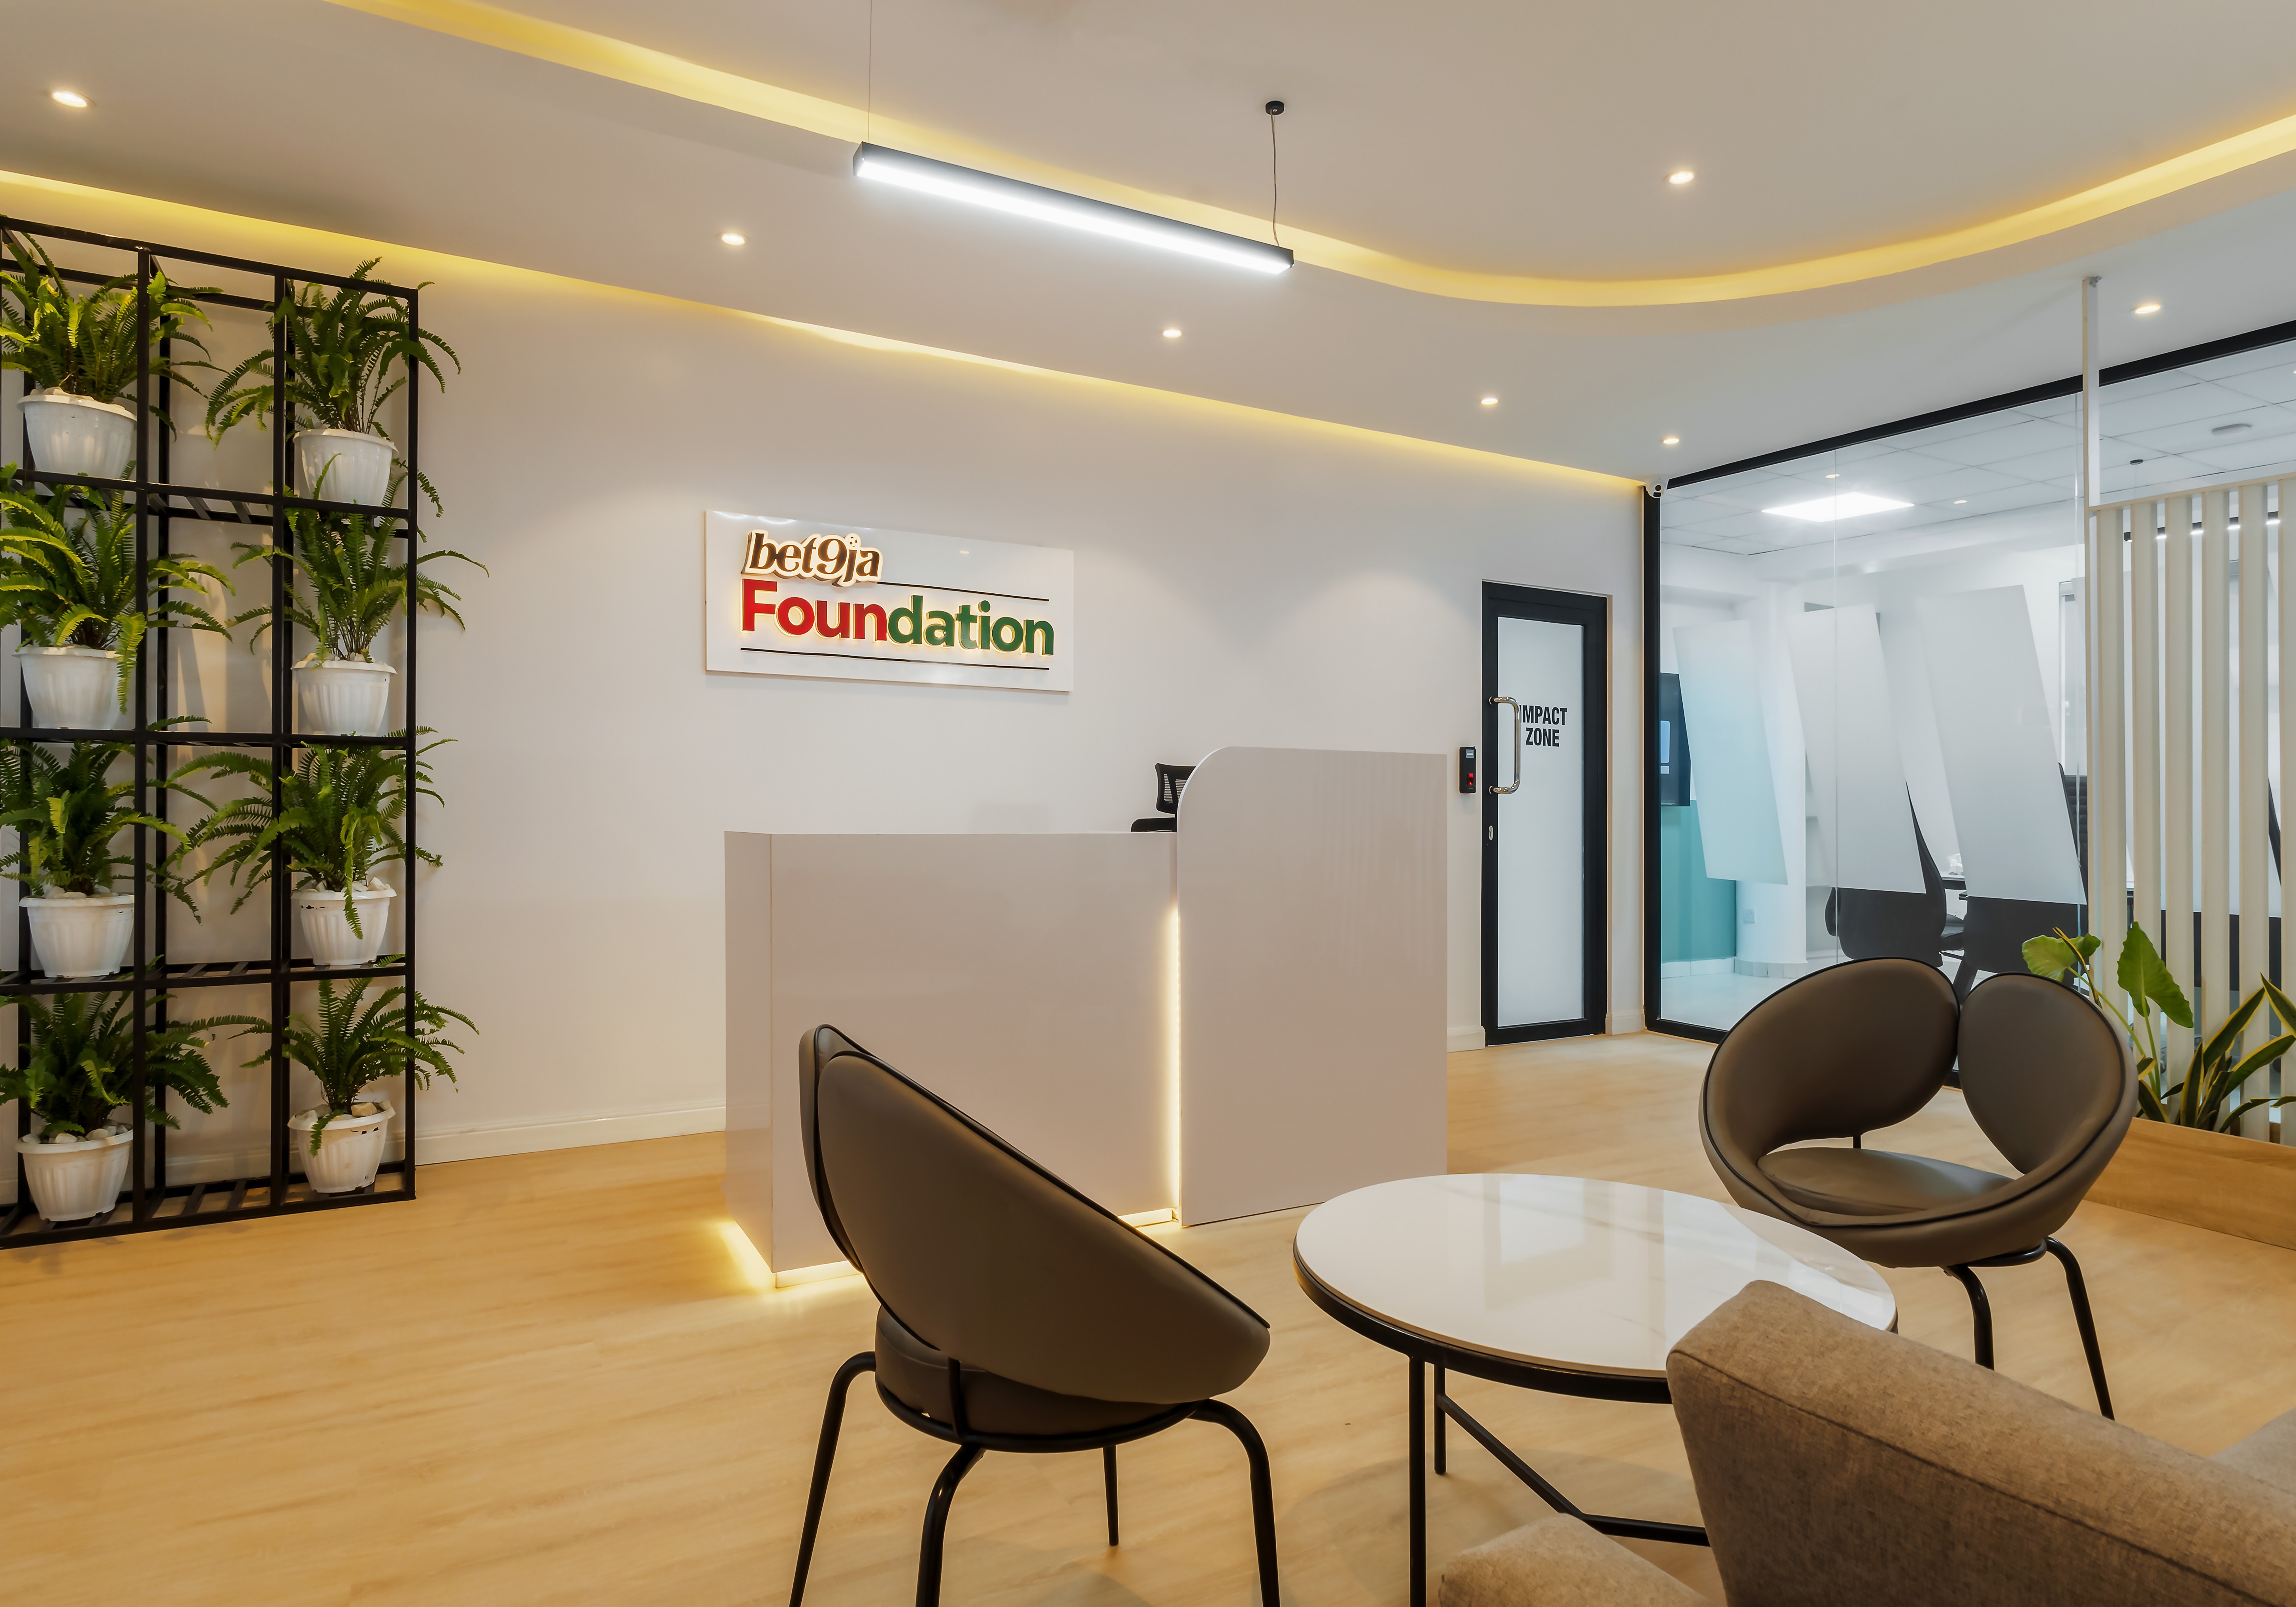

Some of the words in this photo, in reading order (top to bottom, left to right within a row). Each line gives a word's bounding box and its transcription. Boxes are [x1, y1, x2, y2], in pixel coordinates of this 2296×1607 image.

[748, 532, 880, 582] bet9ja
[742, 579, 1054, 655] Foundation
[1526, 727, 1559, 747] ZONE
